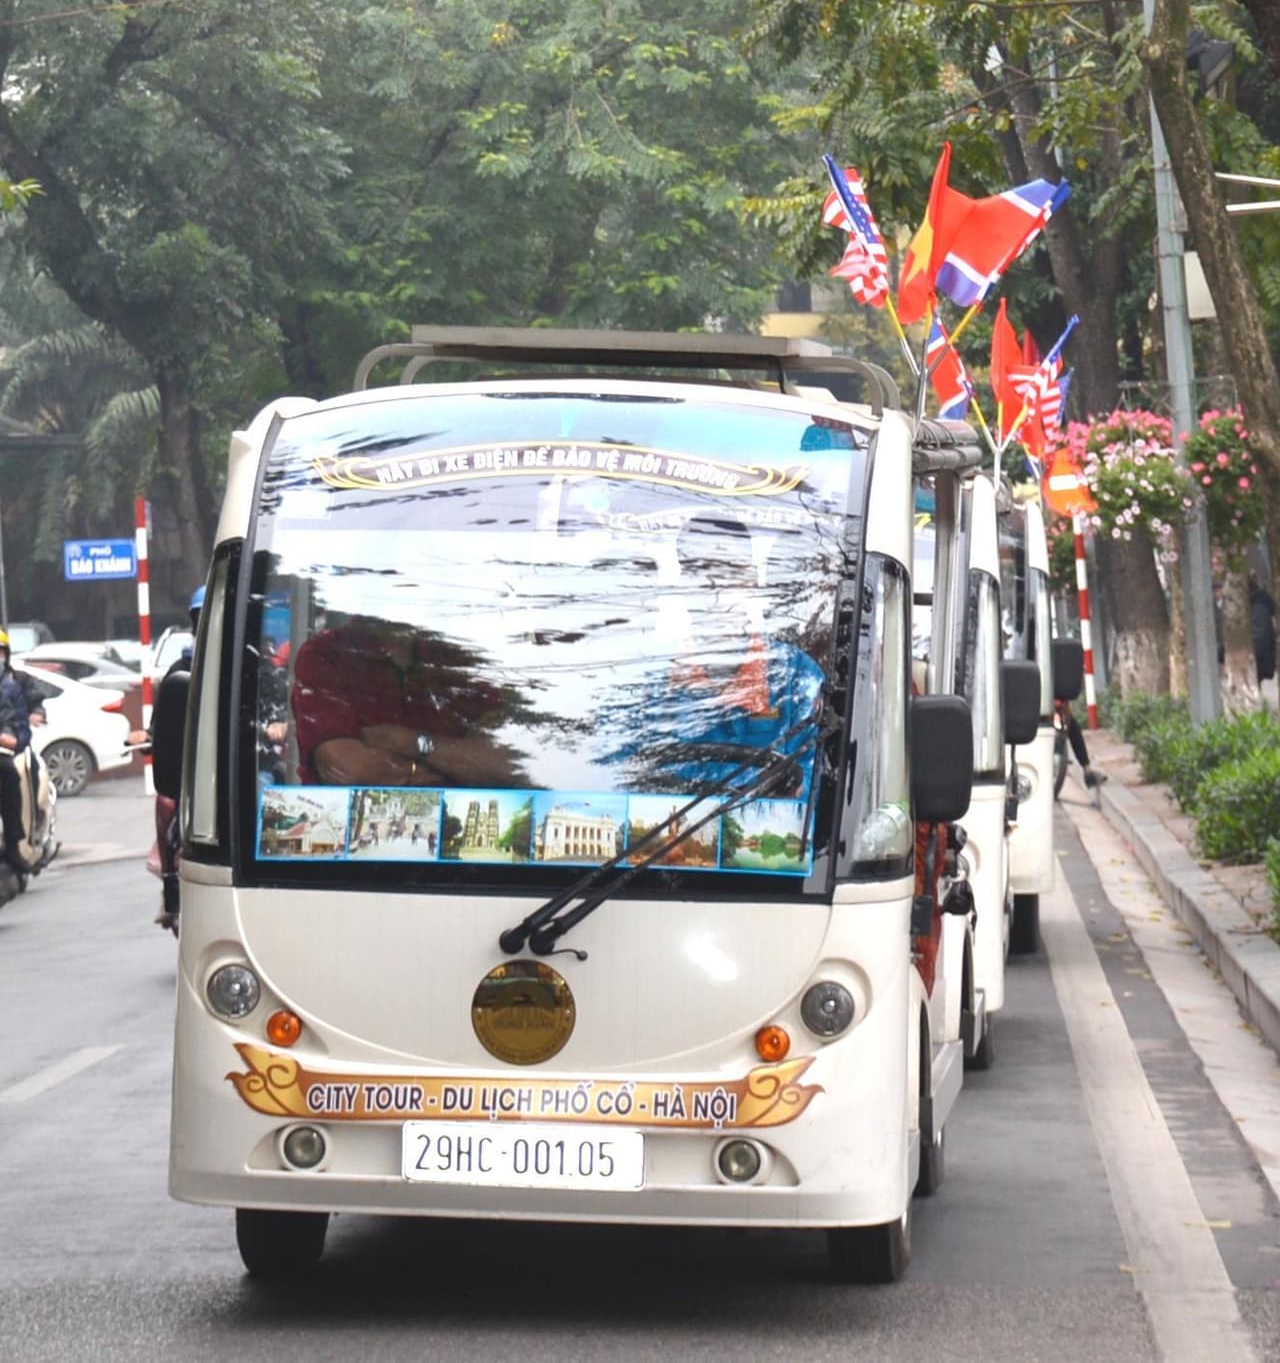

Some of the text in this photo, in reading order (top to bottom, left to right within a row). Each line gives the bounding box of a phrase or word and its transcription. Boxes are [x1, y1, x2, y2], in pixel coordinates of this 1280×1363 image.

[444, 453, 470, 473] XE
[307, 1085, 358, 1111] CITY
[365, 1085, 423, 1112] TOUR
[442, 1087, 473, 1111] DU
[481, 1087, 532, 1119] LỊCH
[540, 1081, 593, 1114] PHỐ
[596, 1083, 635, 1115] CỔ
[653, 1087, 686, 1119] HÀ
[693, 1087, 736, 1128] NỘI
